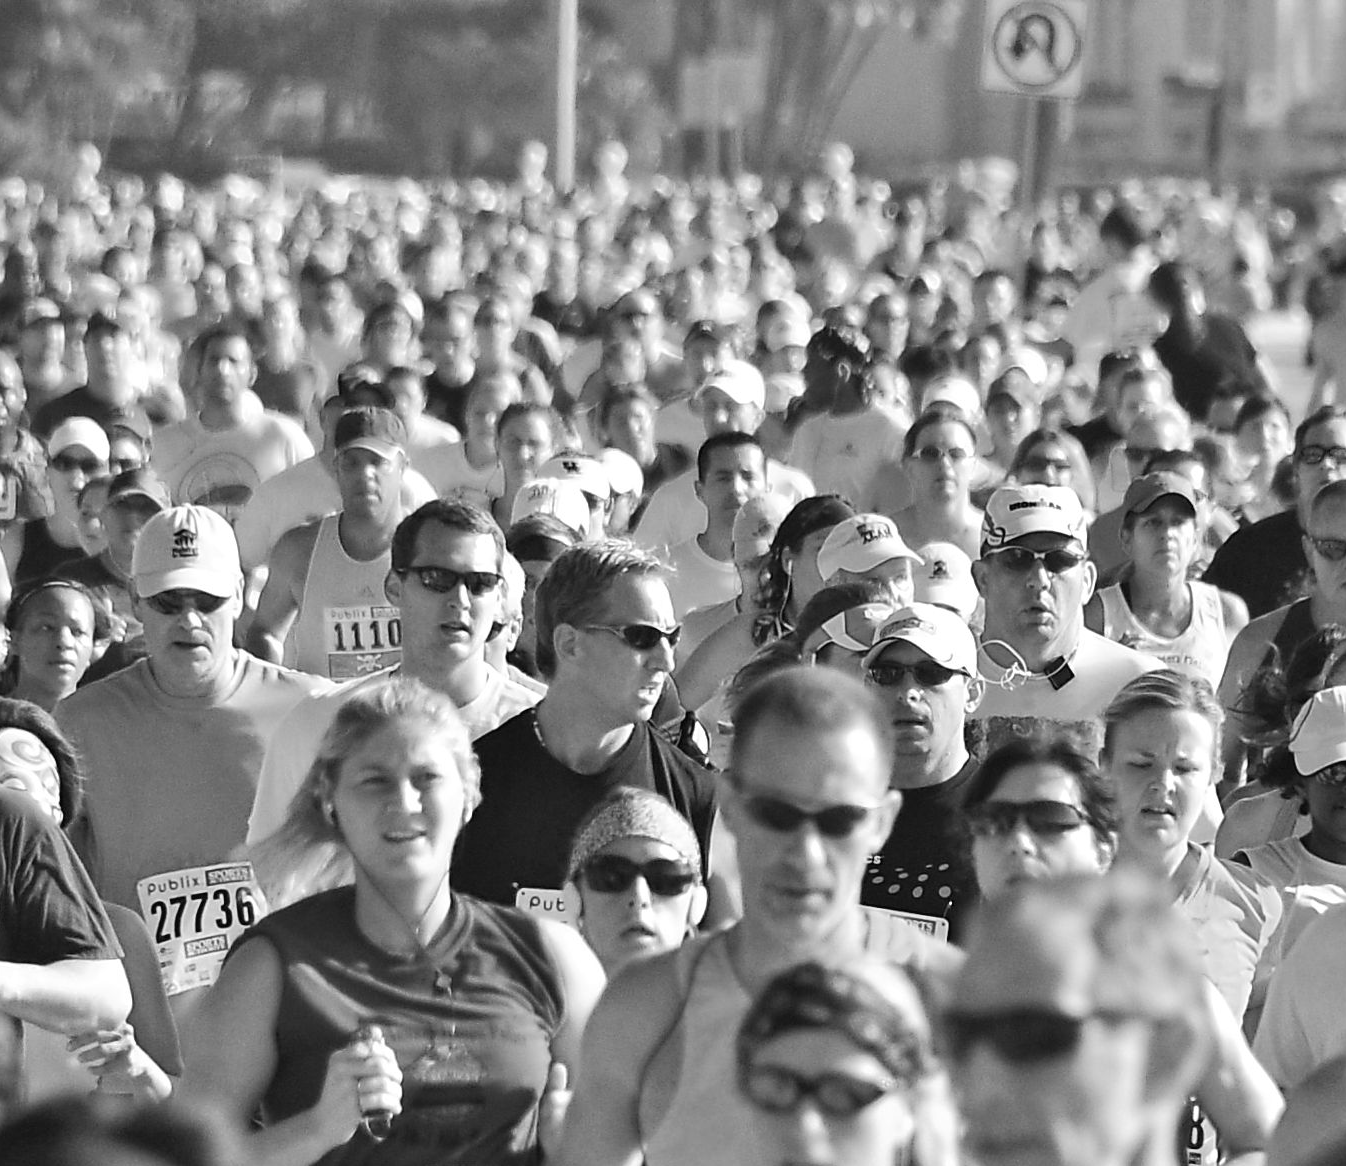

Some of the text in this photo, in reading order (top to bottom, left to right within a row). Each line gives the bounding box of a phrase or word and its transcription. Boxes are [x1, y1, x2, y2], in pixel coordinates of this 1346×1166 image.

[334, 619, 402, 651] 1110
[147, 875, 201, 897] Publix
[150, 886, 256, 945] 27736
